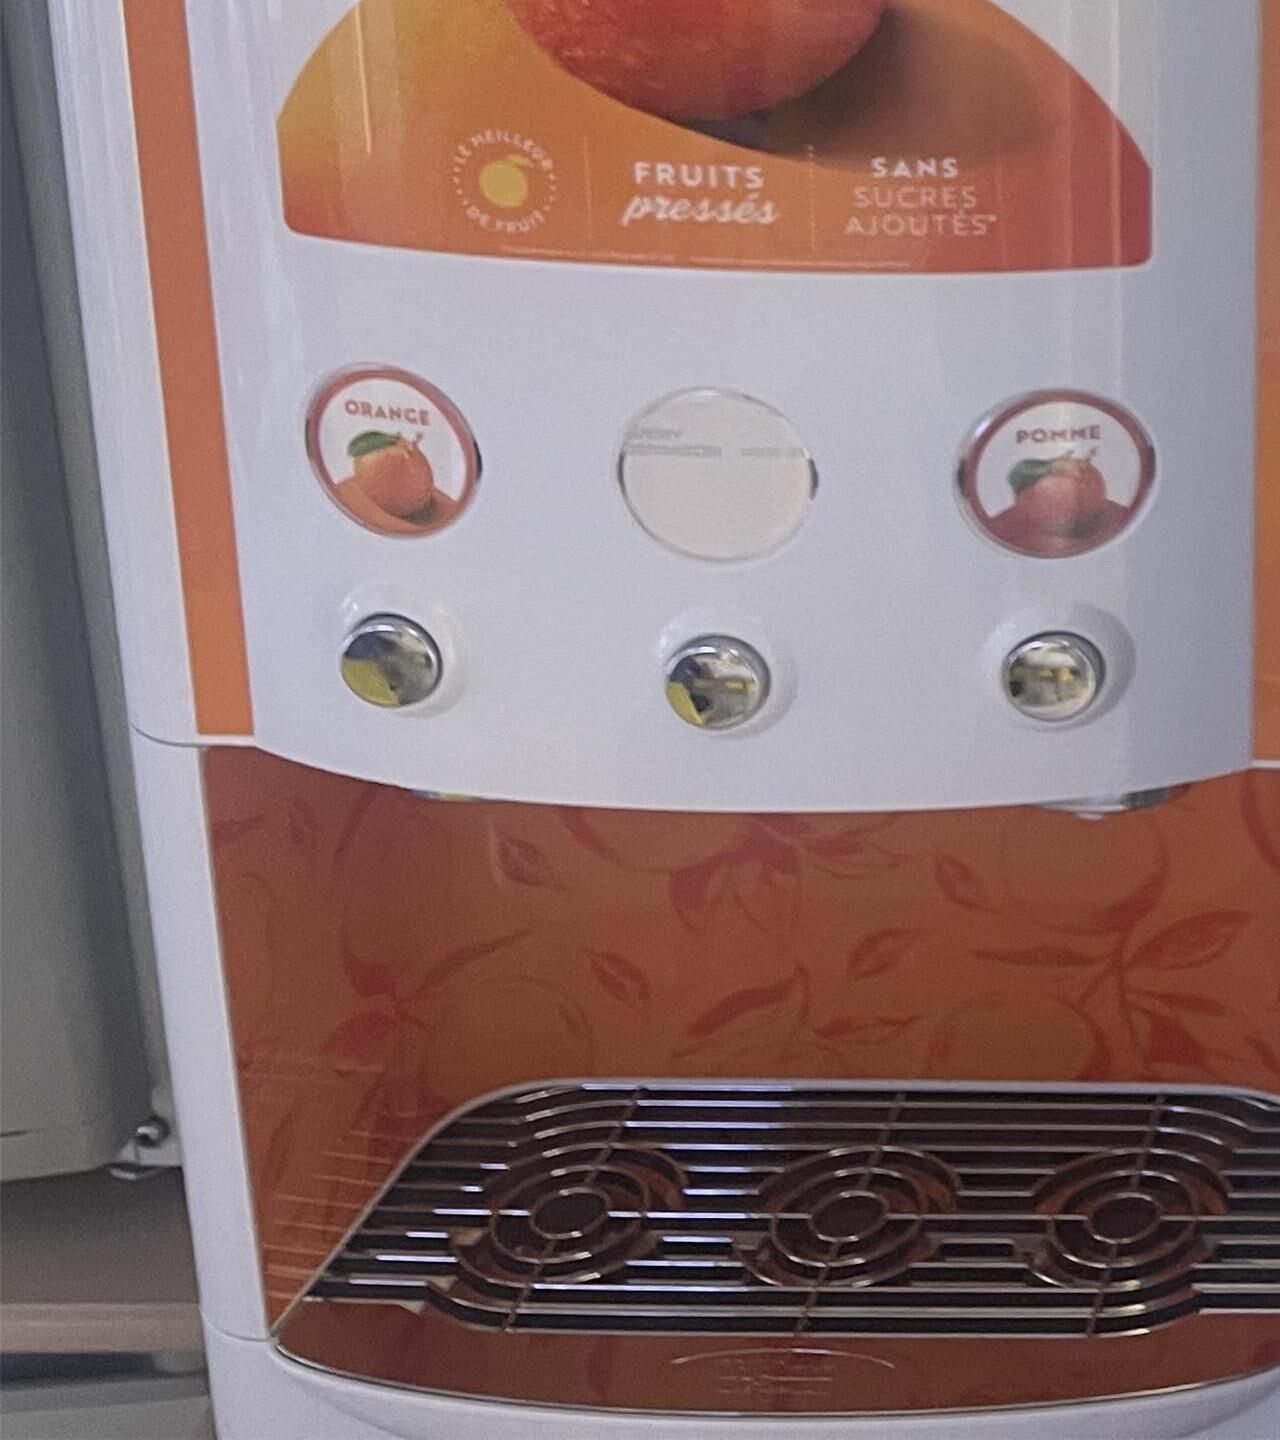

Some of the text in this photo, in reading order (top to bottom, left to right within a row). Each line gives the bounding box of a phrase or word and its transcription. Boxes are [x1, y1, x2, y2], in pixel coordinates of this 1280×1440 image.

[634, 161, 764, 189] FRUITS
[871, 157, 958, 178] SANS
[621, 192, 779, 226] pressés
[854, 186, 977, 209] SUCRES
[345, 399, 429, 426] ORANGE
[1016, 424, 1101, 443] POMME
